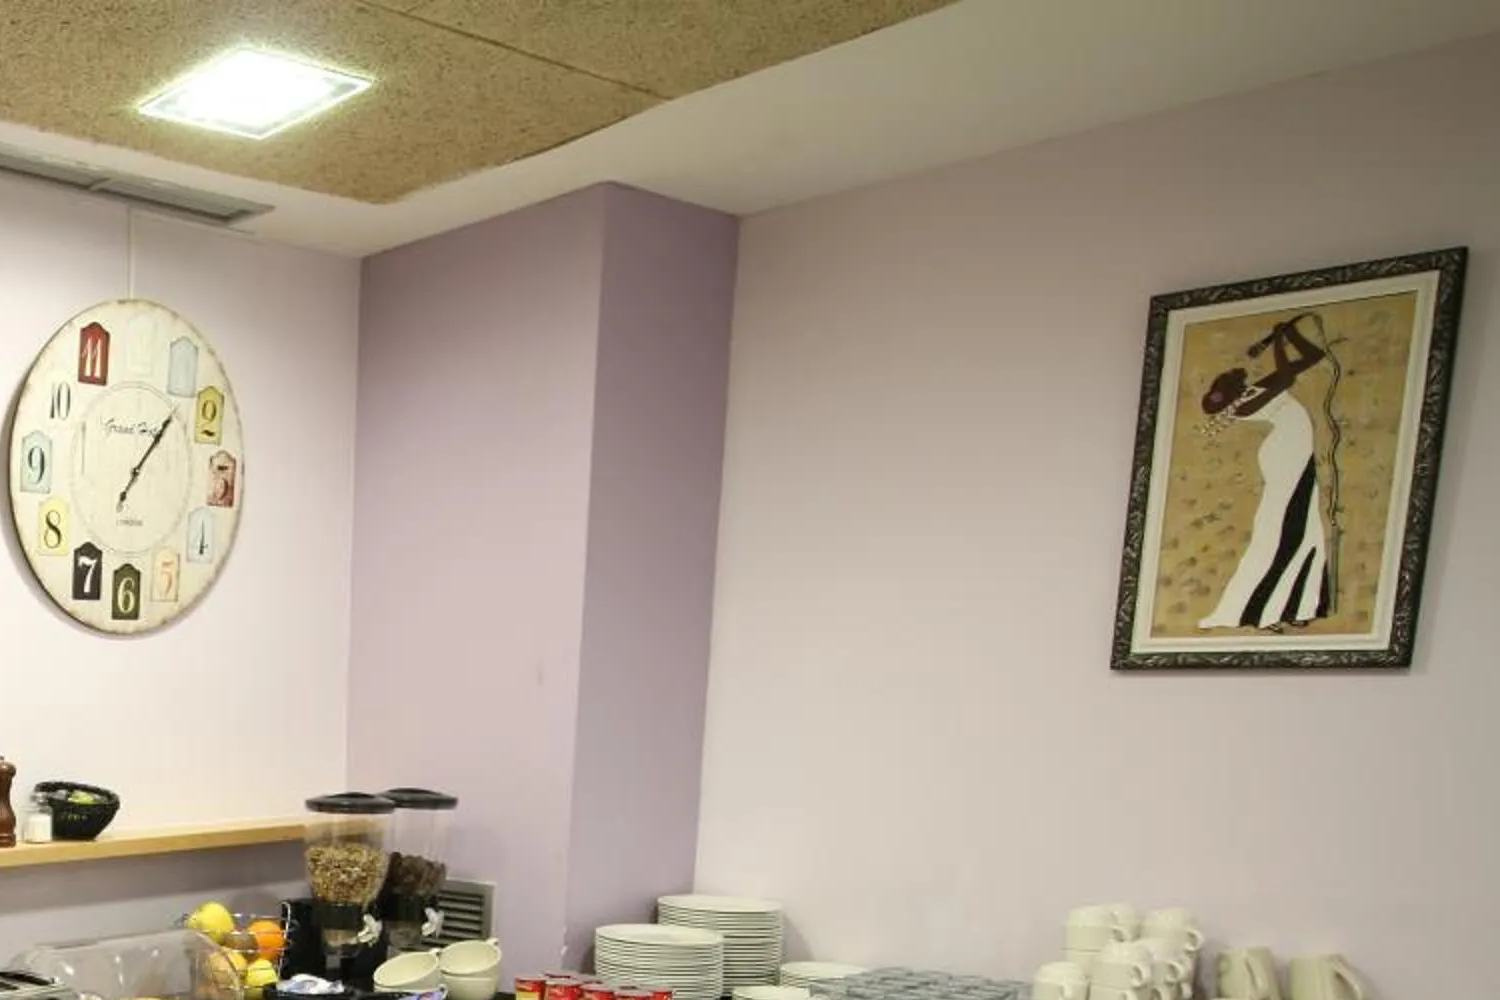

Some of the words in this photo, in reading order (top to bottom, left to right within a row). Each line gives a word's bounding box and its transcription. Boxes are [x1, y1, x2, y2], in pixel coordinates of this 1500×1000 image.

[81, 337, 102, 377] 11
[49, 381, 71, 421] 10
[201, 399, 217, 437] 2
[27, 446, 45, 485] 9
[43, 510, 62, 549] 8
[77, 556, 97, 593] 7
[117, 577, 136, 614] 6
